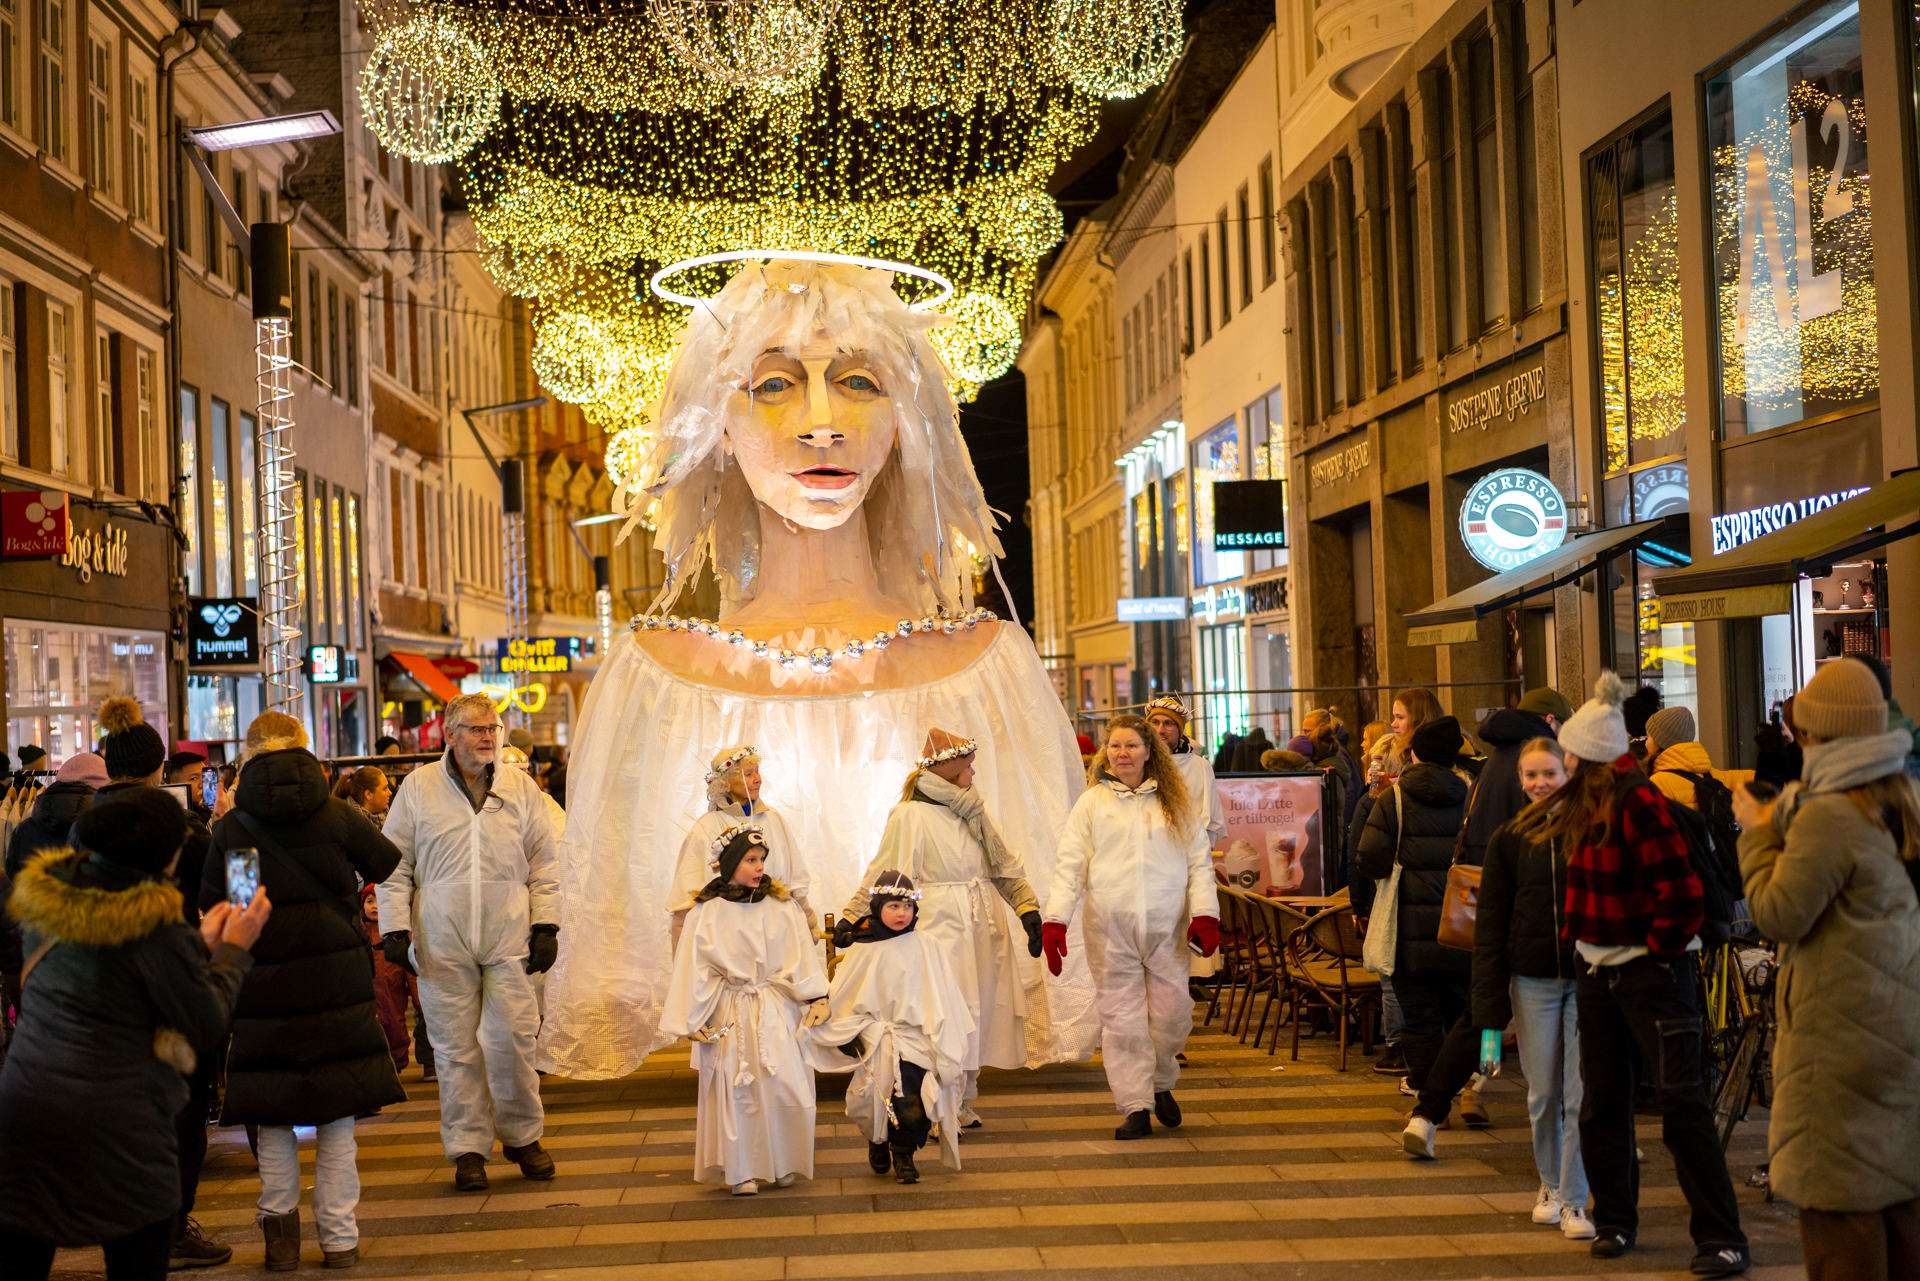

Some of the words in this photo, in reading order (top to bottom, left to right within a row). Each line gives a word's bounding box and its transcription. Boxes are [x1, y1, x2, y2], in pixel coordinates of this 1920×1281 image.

[1449, 384, 1503, 433] SØSTRENE
[1505, 365, 1546, 422] GRENE
[1471, 475, 1558, 515] ESPRESSO
[1216, 532, 1283, 546] MESSAGE
[1711, 501, 1798, 556] ESPRESSO
[106, 522, 128, 577] idé
[1482, 540, 1551, 566] HOUSE
[1664, 600, 1698, 620] ESPRESSO
[1700, 597, 1726, 617] HOUSE
[196, 636, 248, 653] hummel
[1229, 799, 1254, 811] Jule
[1257, 799, 1294, 810] Latte
[1228, 816, 1242, 825] er
[1245, 811, 1295, 827] tilbage!
